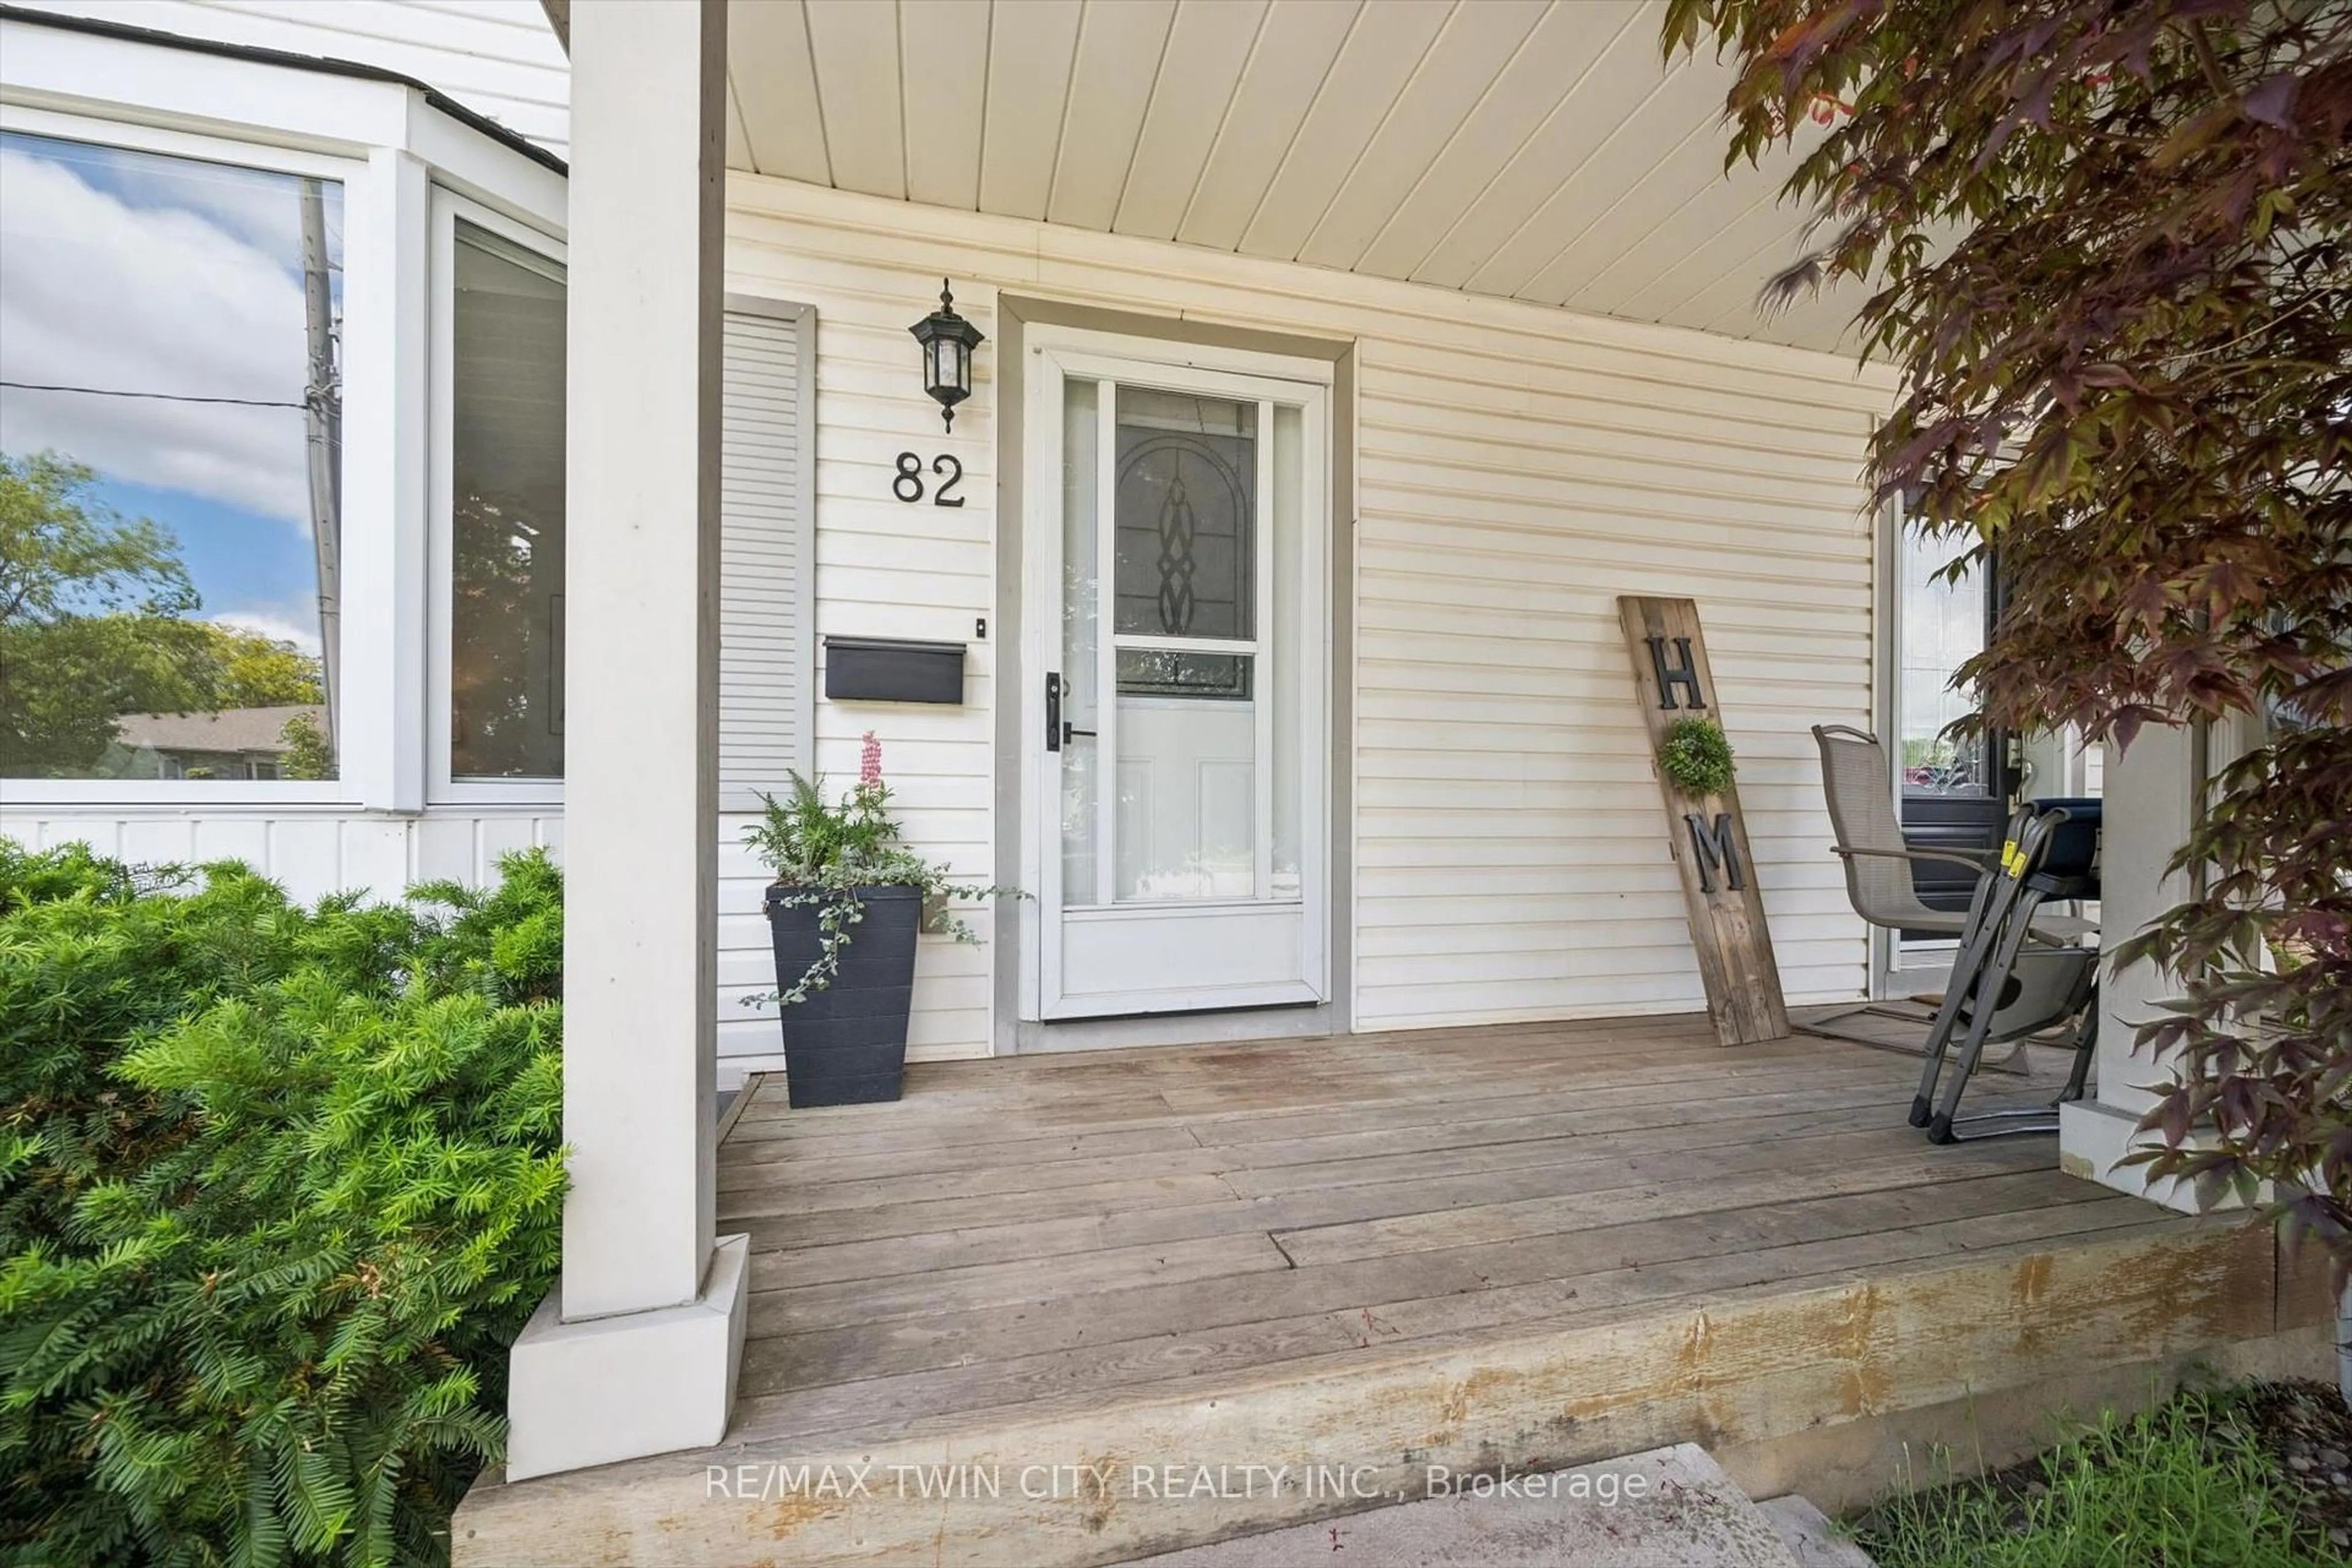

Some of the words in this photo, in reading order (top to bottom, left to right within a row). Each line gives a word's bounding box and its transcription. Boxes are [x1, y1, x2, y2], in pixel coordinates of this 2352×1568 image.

[892, 451, 965, 508] 82
[1645, 636, 1707, 710] H
[1683, 813, 1747, 893] M
